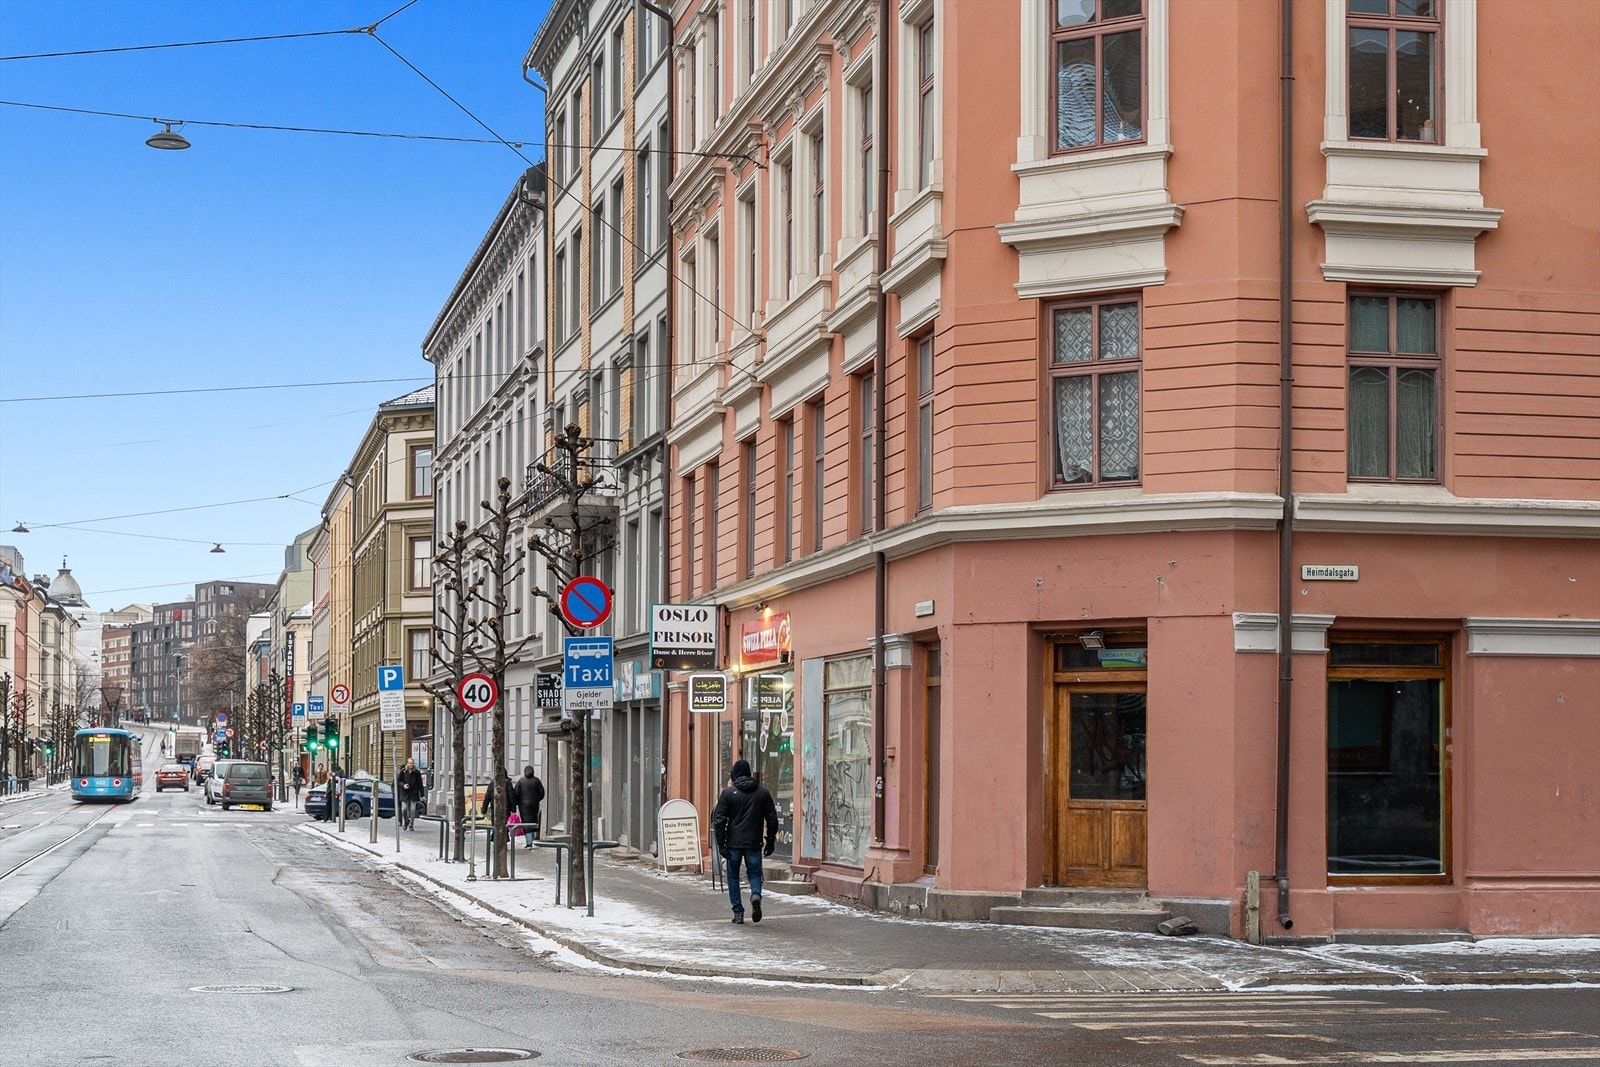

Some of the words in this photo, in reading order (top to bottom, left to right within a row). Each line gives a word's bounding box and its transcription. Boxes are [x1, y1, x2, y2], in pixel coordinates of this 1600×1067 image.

[1306, 567, 1354, 578] Heimdalsgata
[658, 608, 709, 622] OSLO
[760, 627, 777, 650] PIZZA
[383, 669, 398, 688] P
[568, 663, 609, 682] Taxi
[464, 684, 491, 703] 40
[576, 690, 602, 700] Gjelder
[294, 704, 302, 714] P
